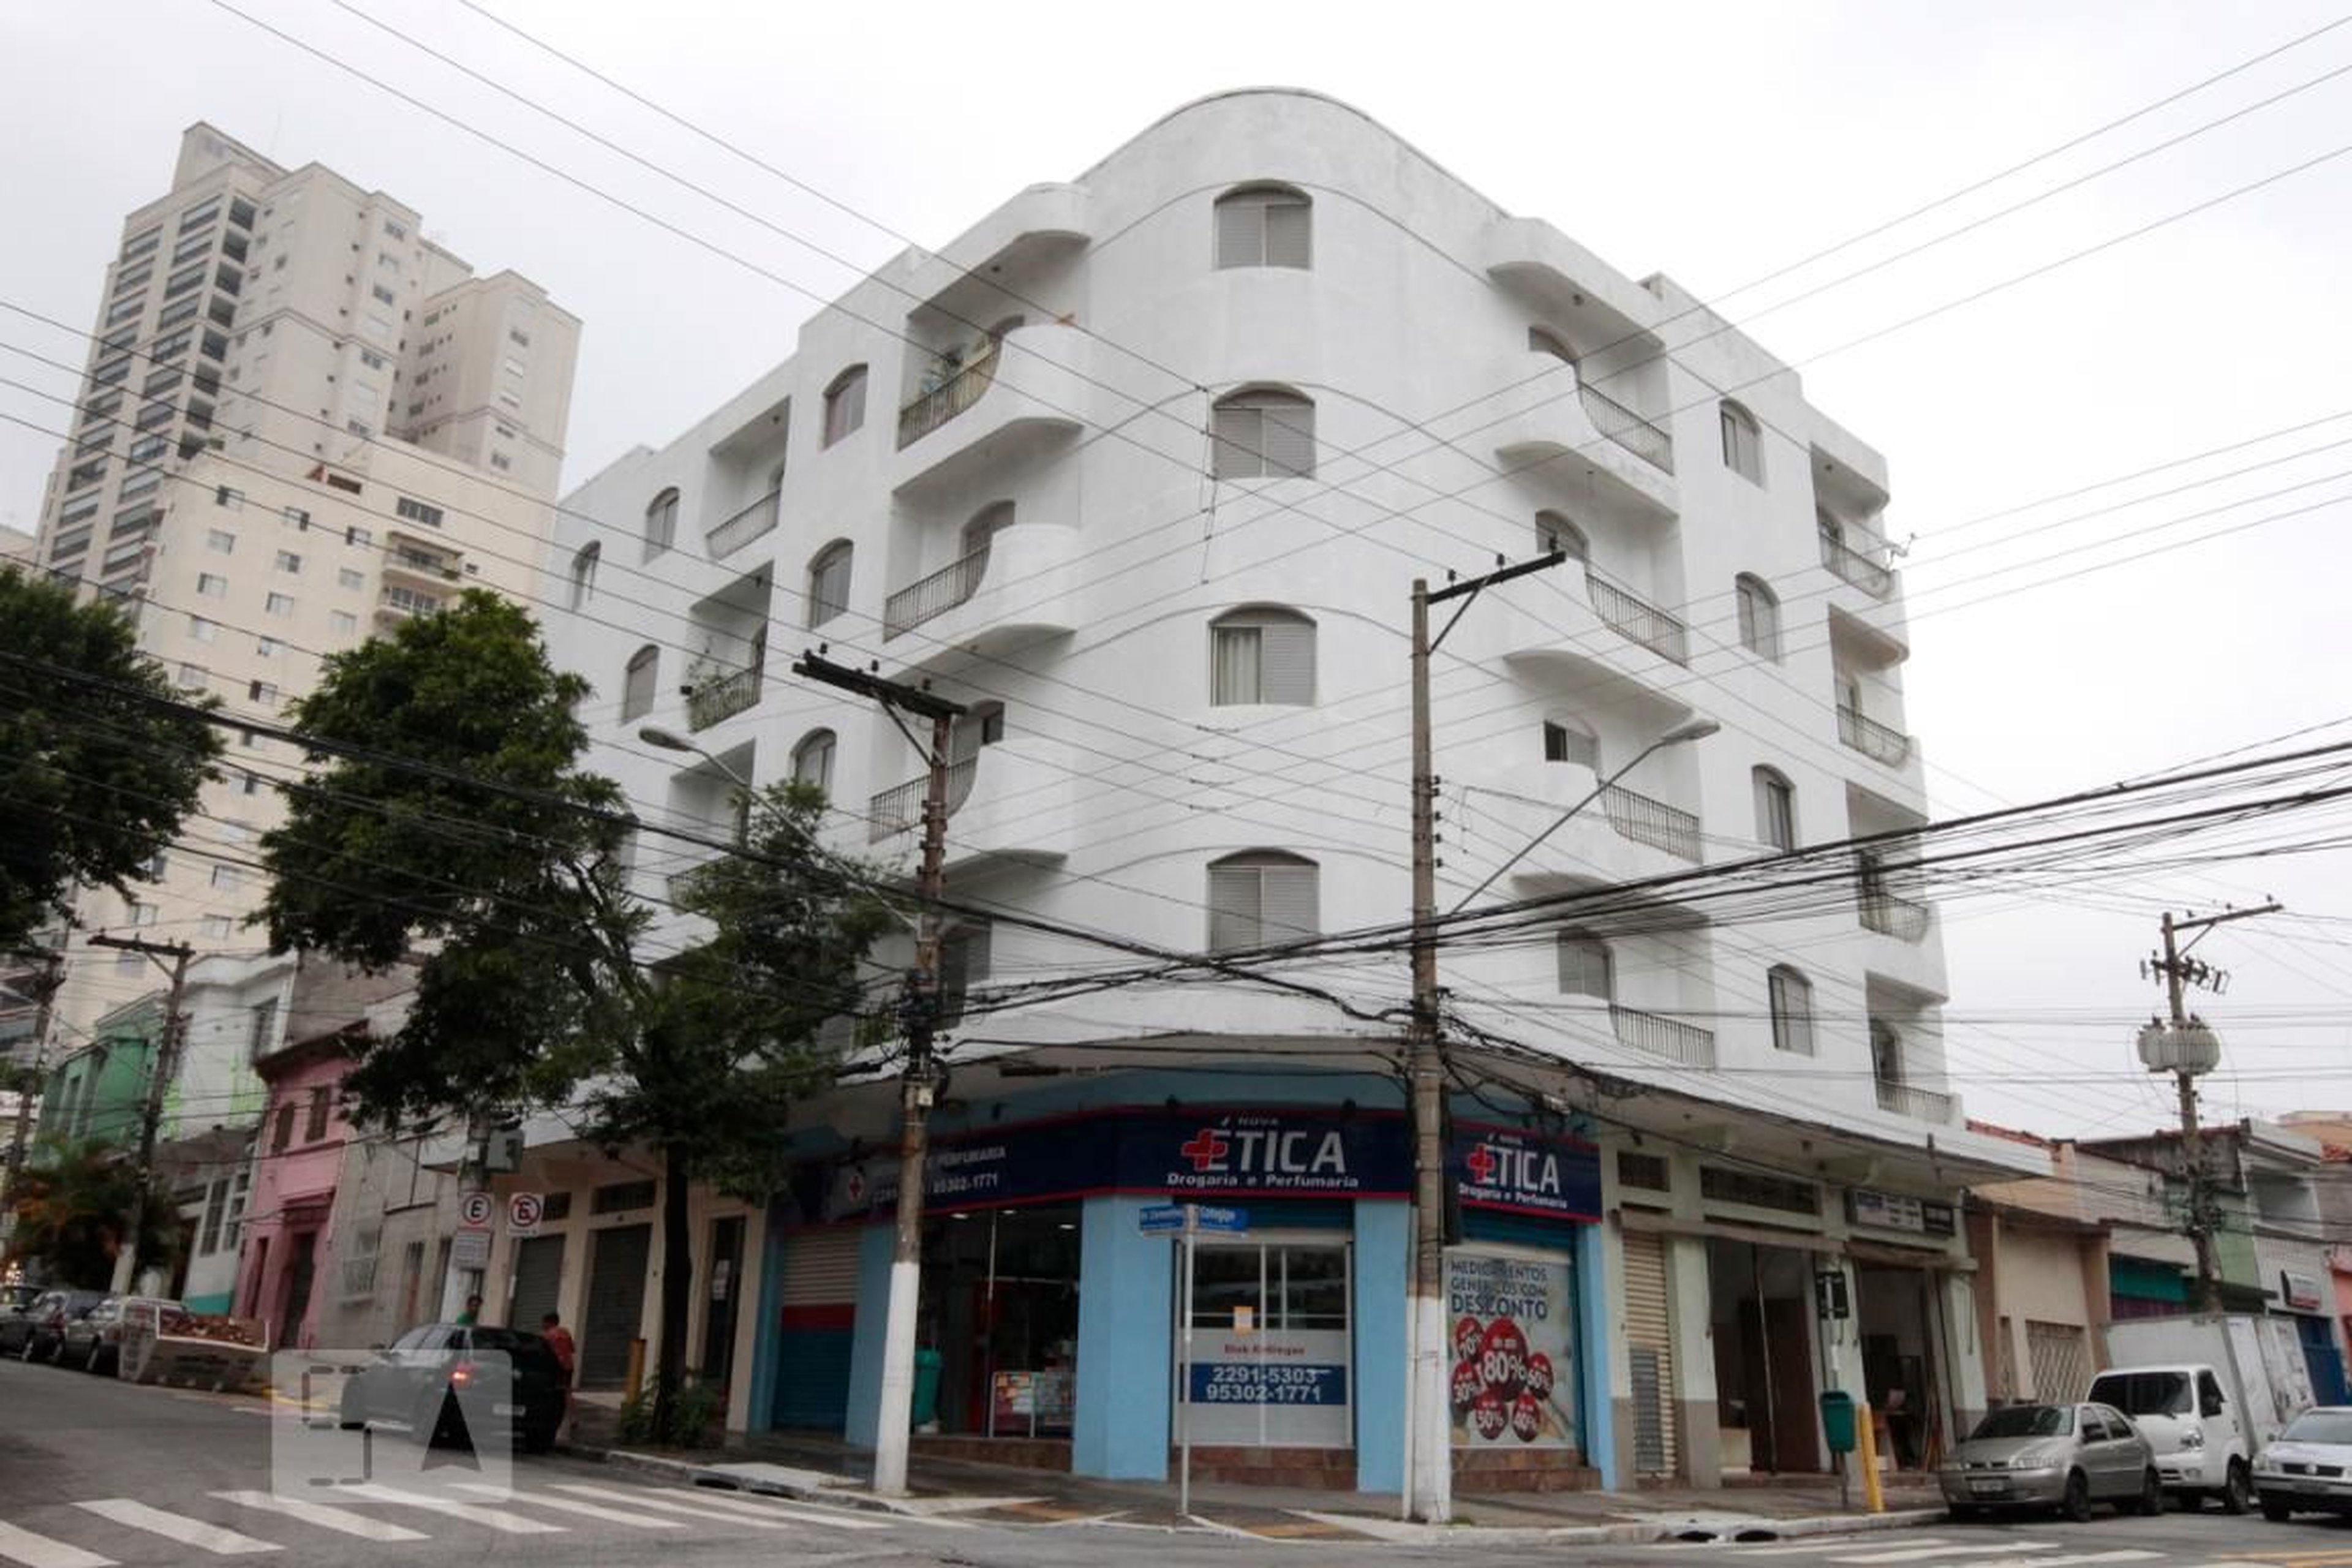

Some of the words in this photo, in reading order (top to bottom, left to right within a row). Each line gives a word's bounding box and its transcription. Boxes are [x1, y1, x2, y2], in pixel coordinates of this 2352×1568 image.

[1166, 1172, 1238, 1189] Drogaria
[1246, 1176, 1257, 1186] e
[1265, 1174, 1359, 1188] Perfumaria
[470, 1199, 484, 1218] E
[1452, 1294, 1548, 1319] DESCONTO
[1212, 1366, 1318, 1384] 2291-5303
[1483, 1349, 1528, 1384] 80%
[1206, 1384, 1321, 1402] 95302-1771
